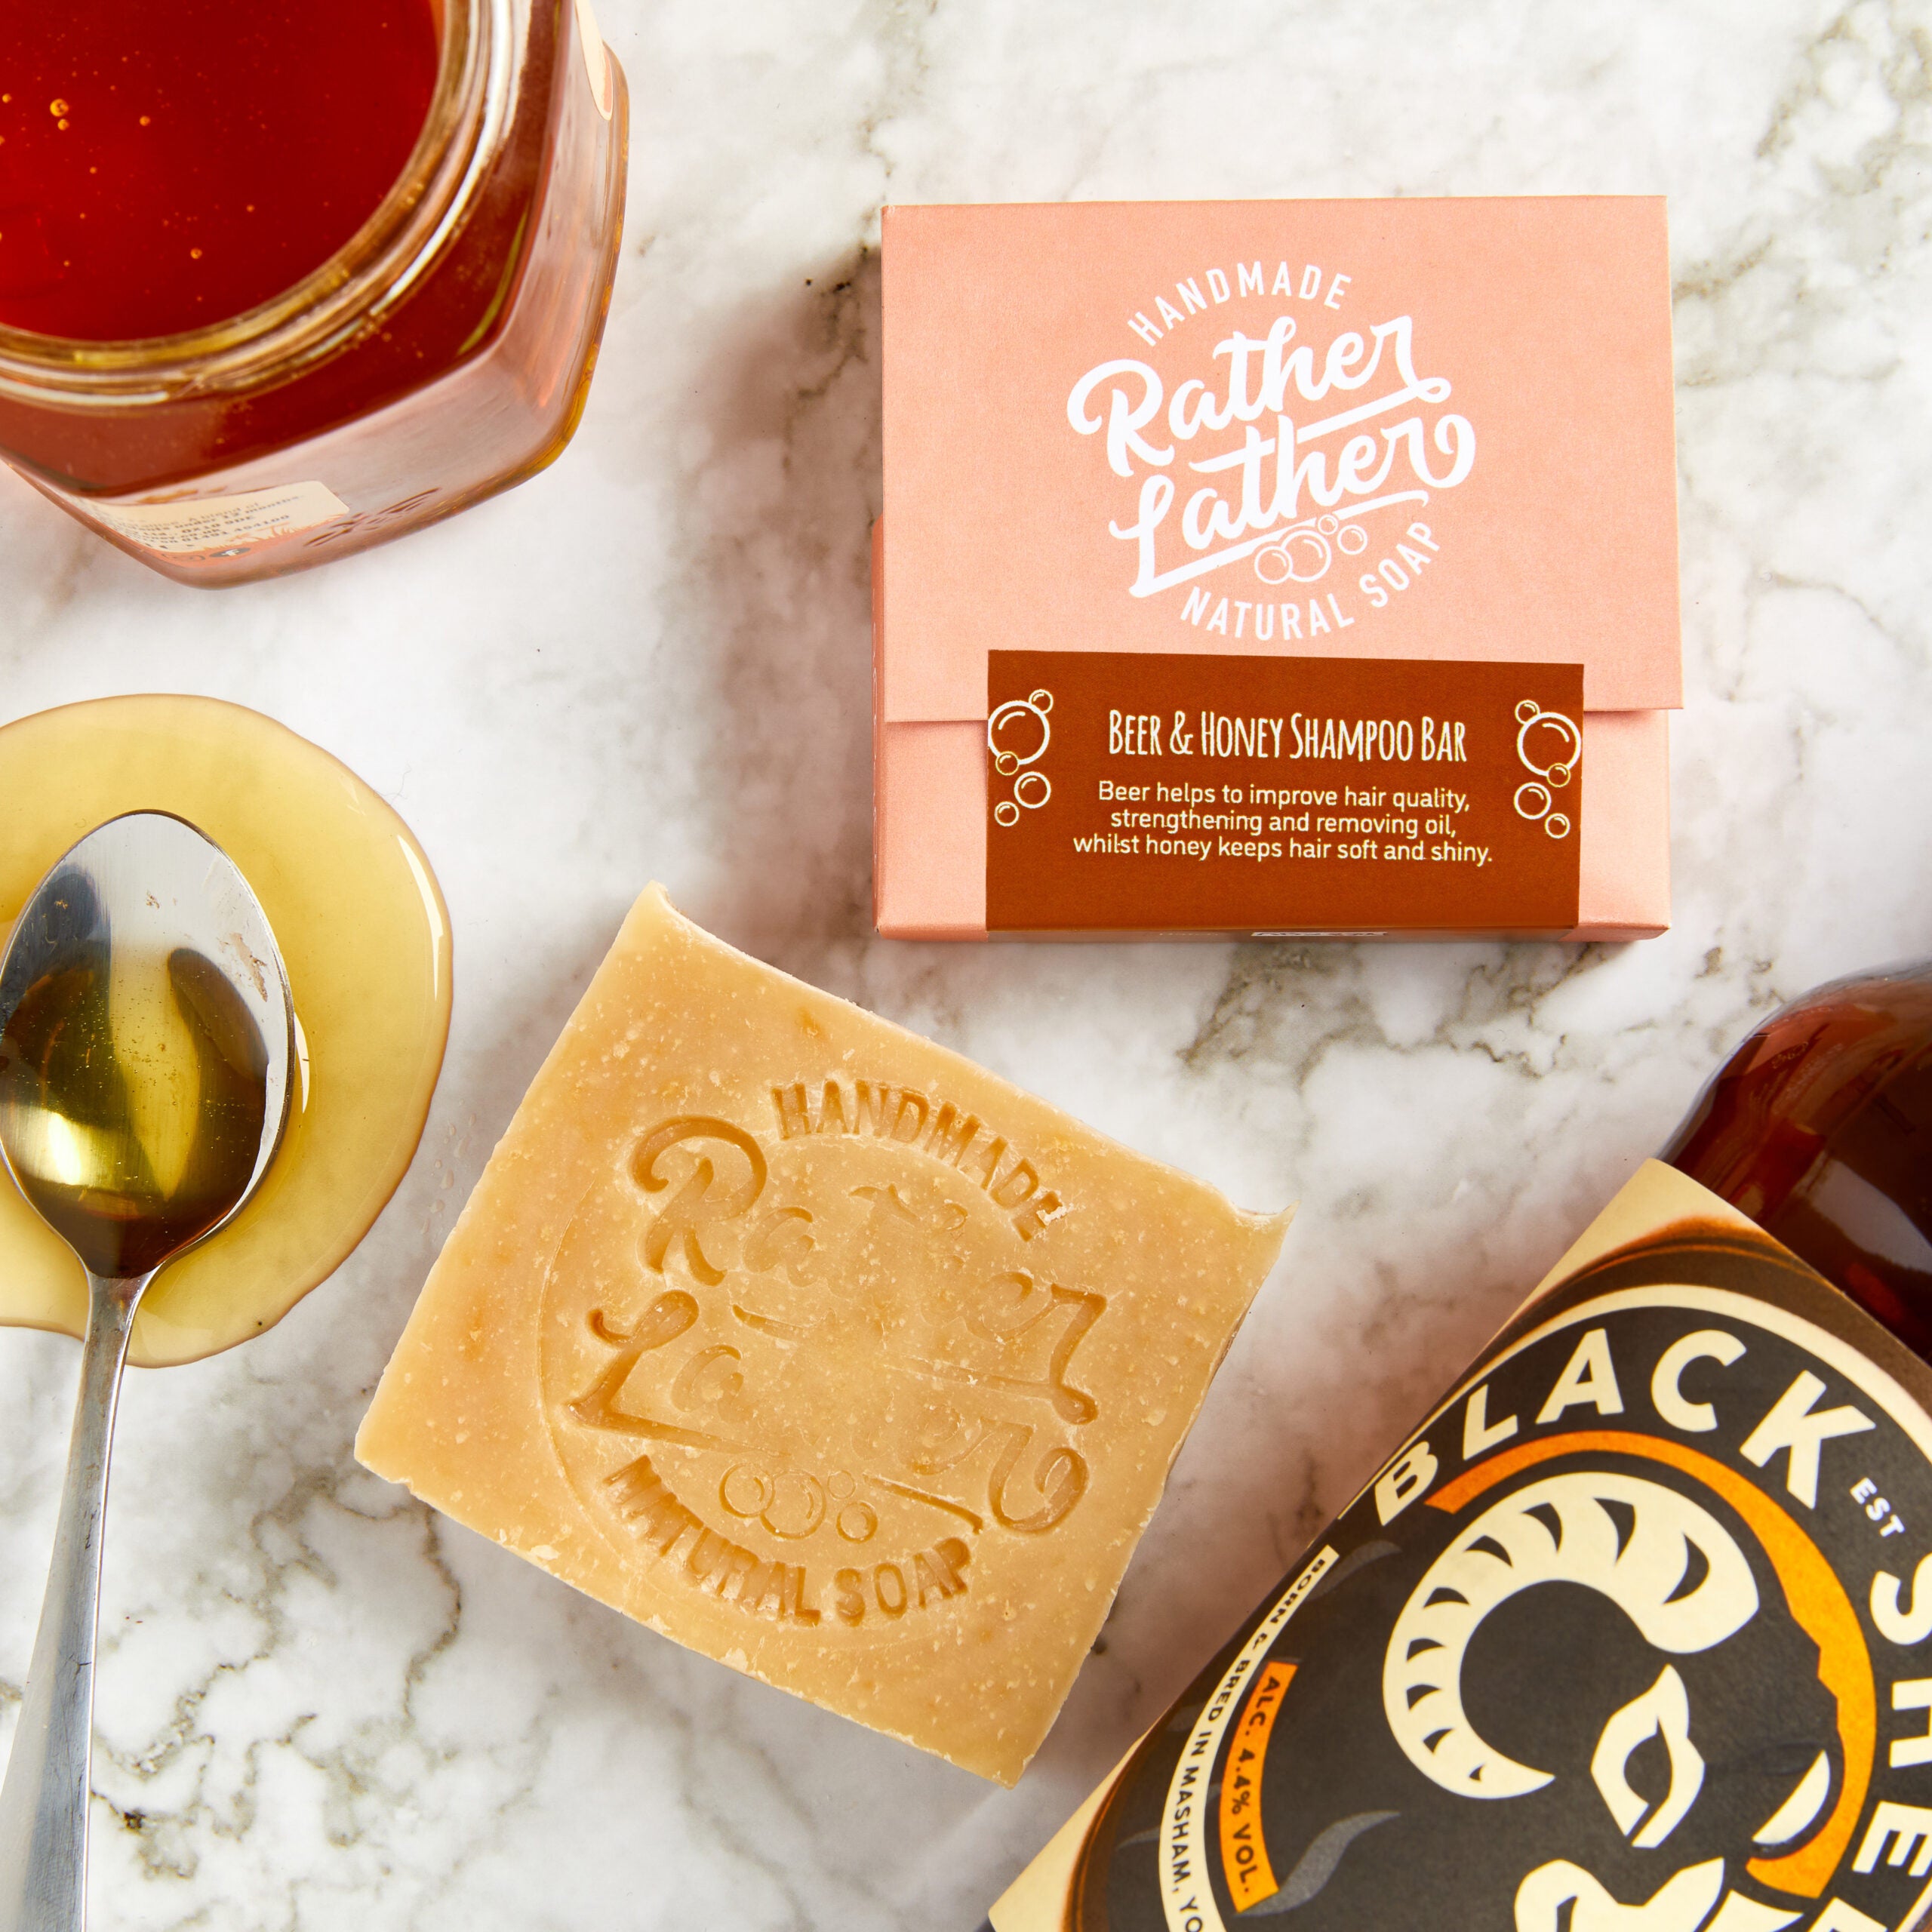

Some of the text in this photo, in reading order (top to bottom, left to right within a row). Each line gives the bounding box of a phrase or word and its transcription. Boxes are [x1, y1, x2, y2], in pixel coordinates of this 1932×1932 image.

[1128, 260, 1352, 347] HANDMADE
[1067, 315, 1451, 477] Rather
[1108, 414, 1476, 598] Lather
[1180, 521, 1440, 641] NATURAL SOAP
[1109, 709, 1467, 762] BEER & HONEY SHAMPOO BAR
[1099, 780, 1470, 814] Beer helps to improve hair quality,
[1111, 809, 1457, 839] strengthening and removing oil,
[1073, 832, 1493, 867] whilst honey keeps hair soft and shiny.
[771, 1080, 1068, 1242] HANDMADE
[566, 1288, 1089, 1535] Laer
[1850, 1477, 1905, 1537] EST
[835, 1537, 971, 1626] SOAP
[1269, 1558, 1325, 1624] BORN
[1374, 1327, 1932, 1932] BLACK SHE
[1208, 1660, 1251, 1722] BRED
[1190, 1731, 1212, 1757] IN
[1231, 1675, 1281, 1893] ALC. 4.4% VOL.
